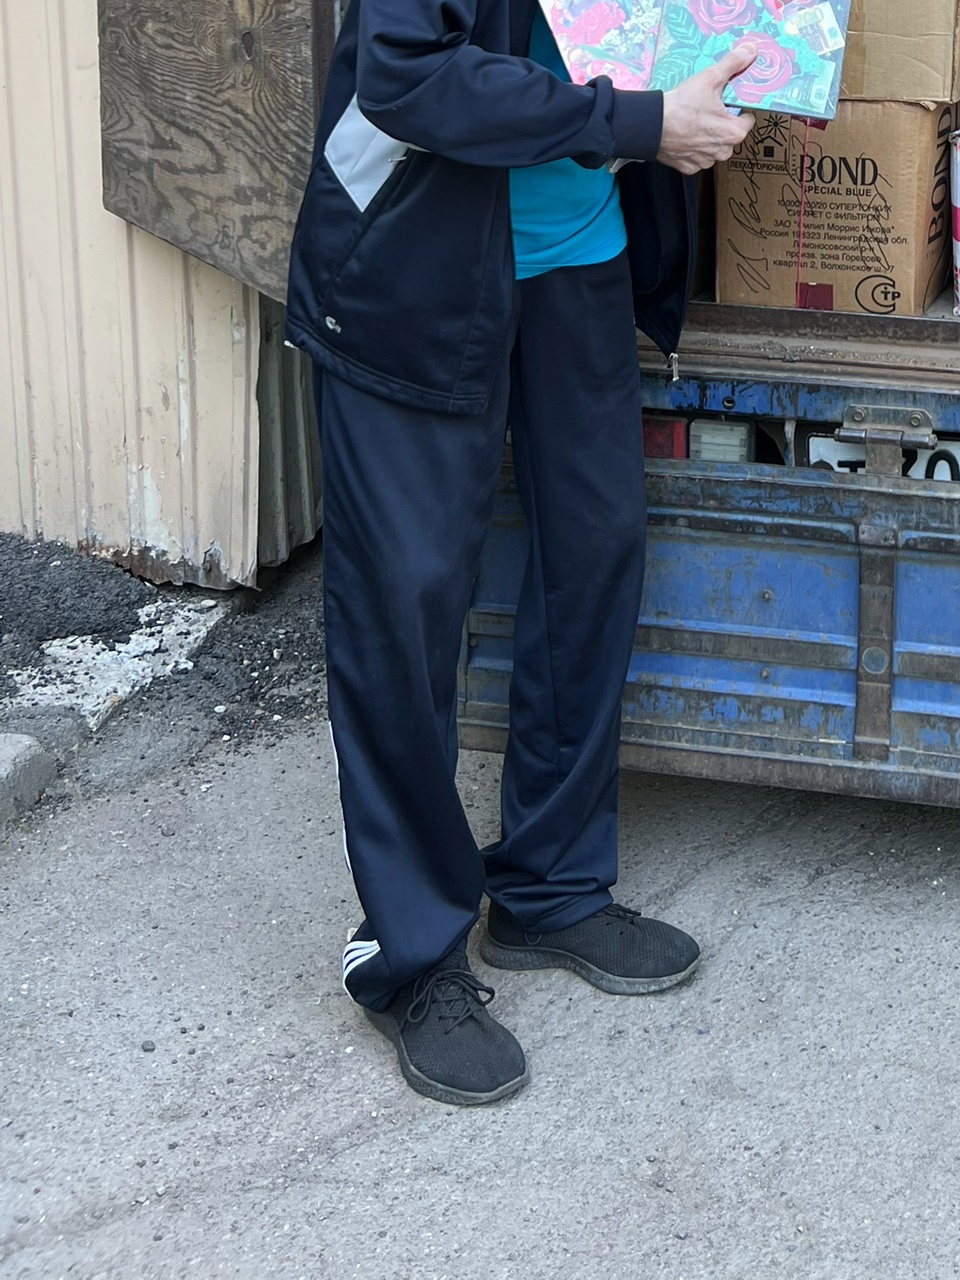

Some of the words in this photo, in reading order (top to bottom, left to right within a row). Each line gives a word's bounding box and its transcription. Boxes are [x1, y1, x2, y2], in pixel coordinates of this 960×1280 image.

[799, 154, 879, 186] BOND
[801, 185, 843, 196] SPECIAL
[845, 188, 872, 197] BLUE
[773, 219, 792, 228] ЗАО
[826, 223, 860, 234] Моррис
[759, 227, 789, 238] Россия
[891, 236, 910, 245] обл.
[819, 252, 840, 261] зона
